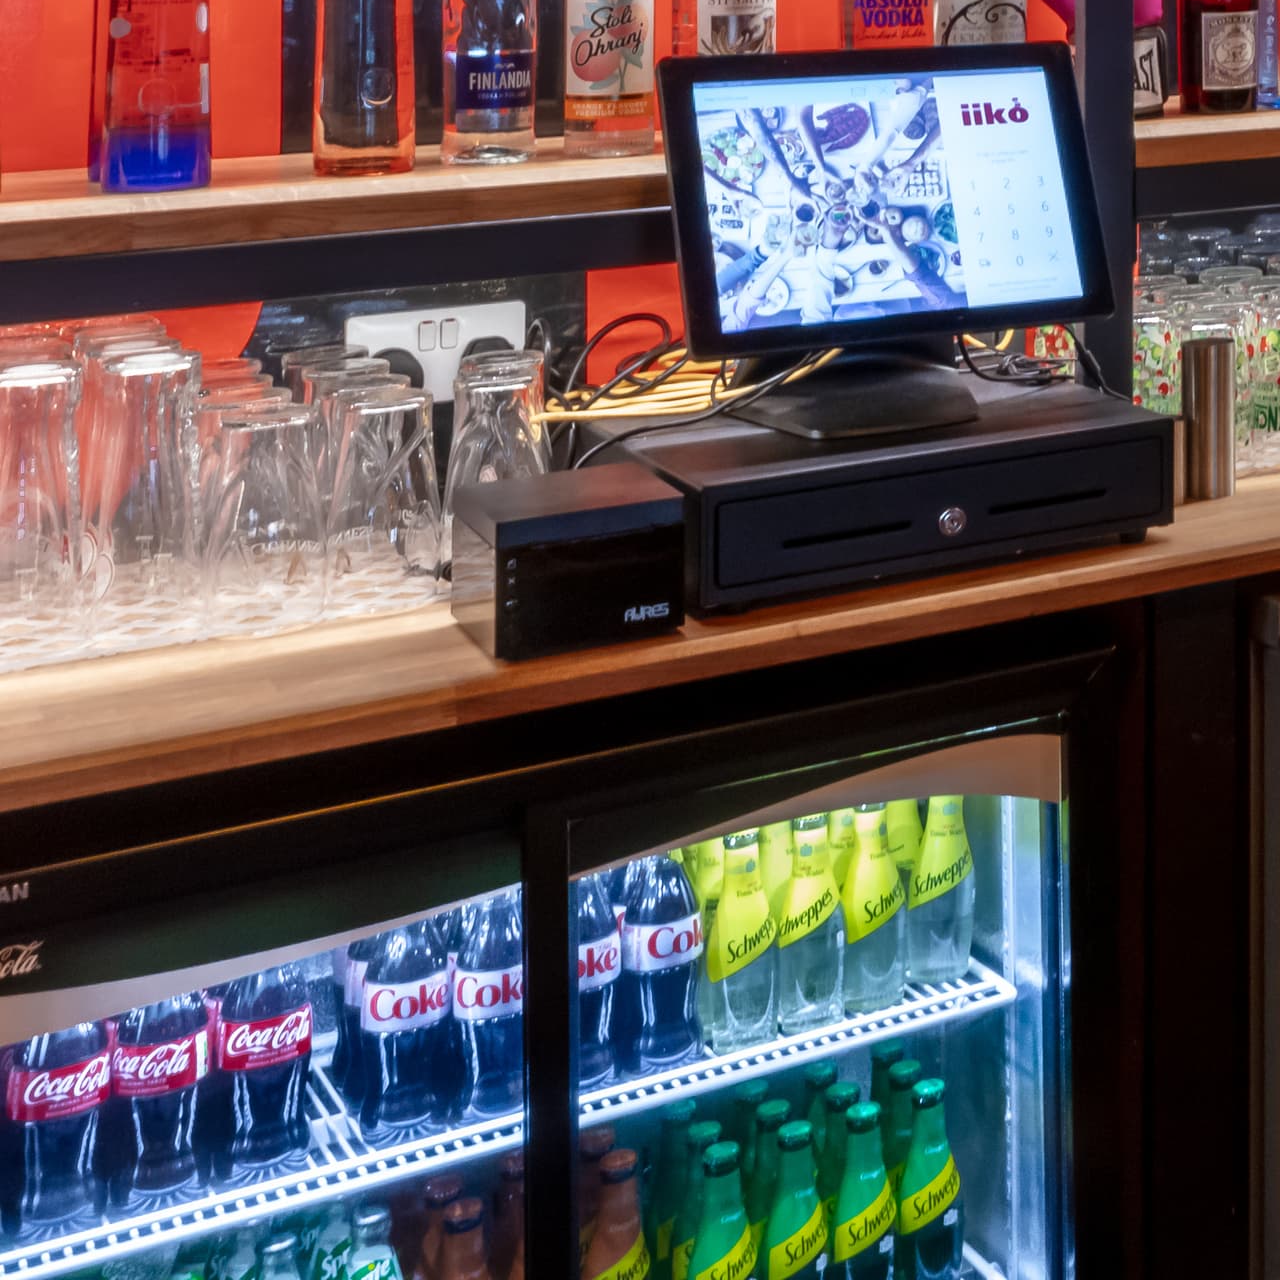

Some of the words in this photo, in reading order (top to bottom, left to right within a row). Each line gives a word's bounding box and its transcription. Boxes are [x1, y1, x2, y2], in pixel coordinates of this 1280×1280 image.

[590, 5, 634, 39] Stoli
[861, 9, 925, 28] VODKA
[574, 23, 645, 68] Ohranj
[469, 70, 531, 91] FINLANDIA
[1002, 176, 1011, 190] 2
[1036, 175, 1045, 187] 3
[973, 205, 982, 217] 4
[1007, 204, 1016, 216] 5
[1041, 200, 1050, 213] 6
[977, 231, 985, 243] 7
[1011, 228, 1020, 241] 8
[1045, 226, 1054, 239] 9
[1015, 254, 1025, 267] 0
[369, 982, 450, 1021] Coke
